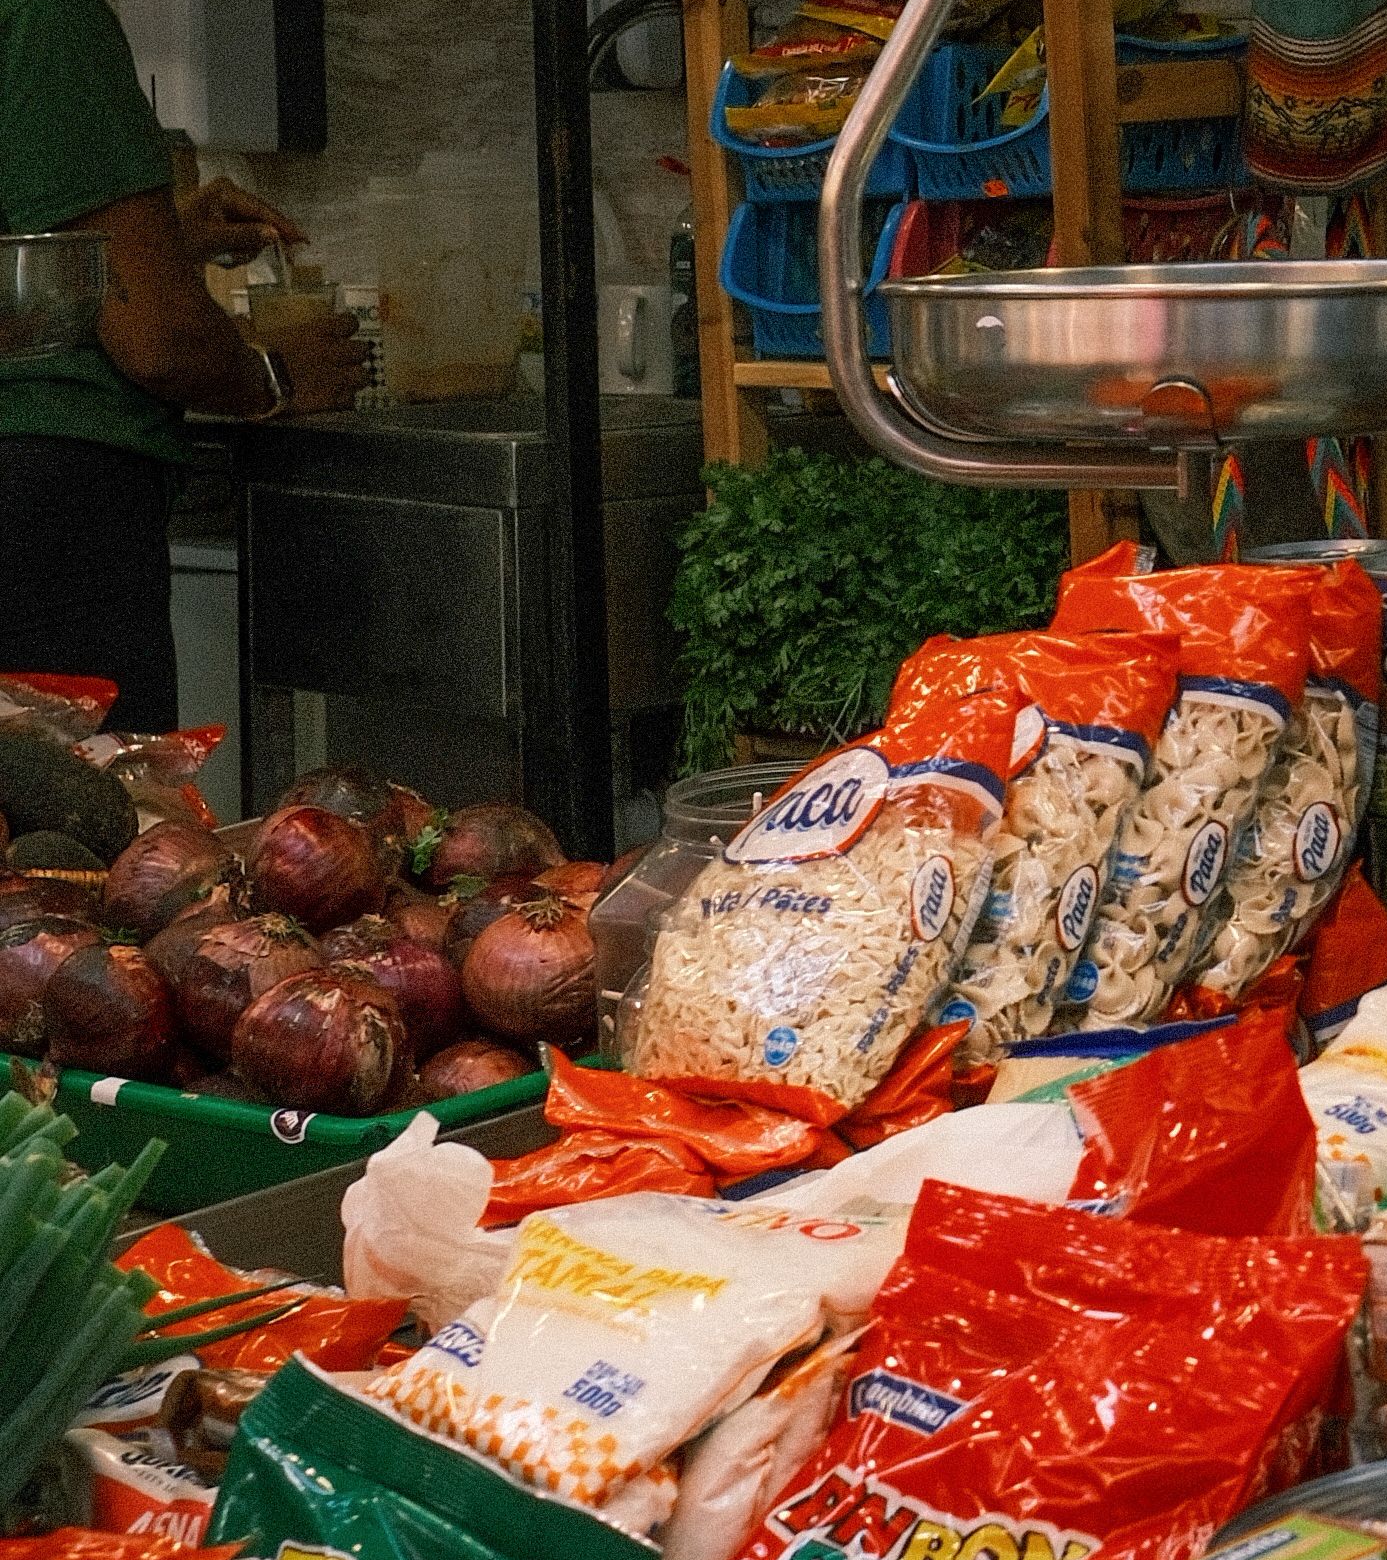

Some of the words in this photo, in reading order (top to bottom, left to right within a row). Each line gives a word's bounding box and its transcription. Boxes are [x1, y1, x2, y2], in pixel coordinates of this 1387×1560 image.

[1188, 832, 1225, 900] Paca
[1302, 808, 1338, 875] Paca
[919, 866, 948, 934] Paca
[1061, 875, 1095, 944] Paca
